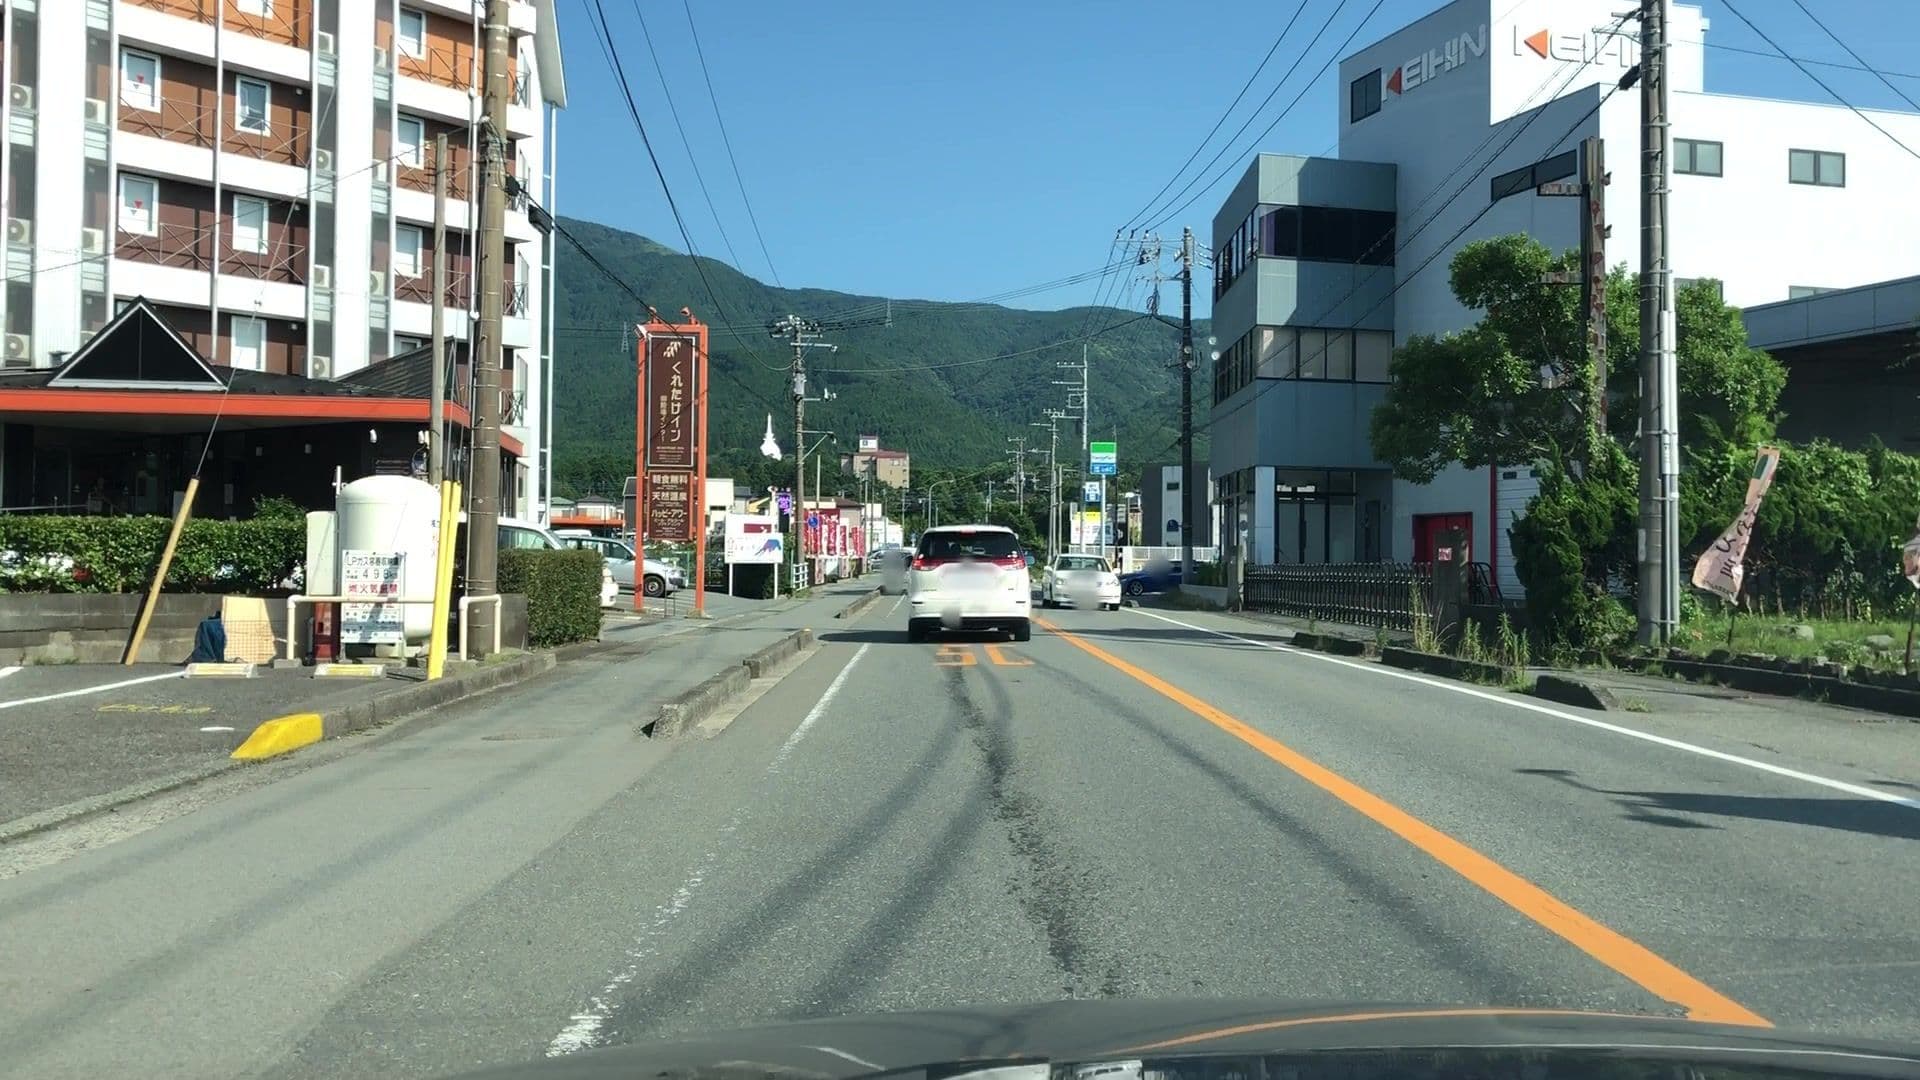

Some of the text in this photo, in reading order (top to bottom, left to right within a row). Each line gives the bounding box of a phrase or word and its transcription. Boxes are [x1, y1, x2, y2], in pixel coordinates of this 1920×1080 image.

[1381, 24, 1486, 103] KEIHIN
[659, 395, 668, 442] インター
[670, 361, 683, 442] くれたけイン
[651, 509, 688, 518] ハッピーアワー
[652, 491, 688, 501] 天然温泉
